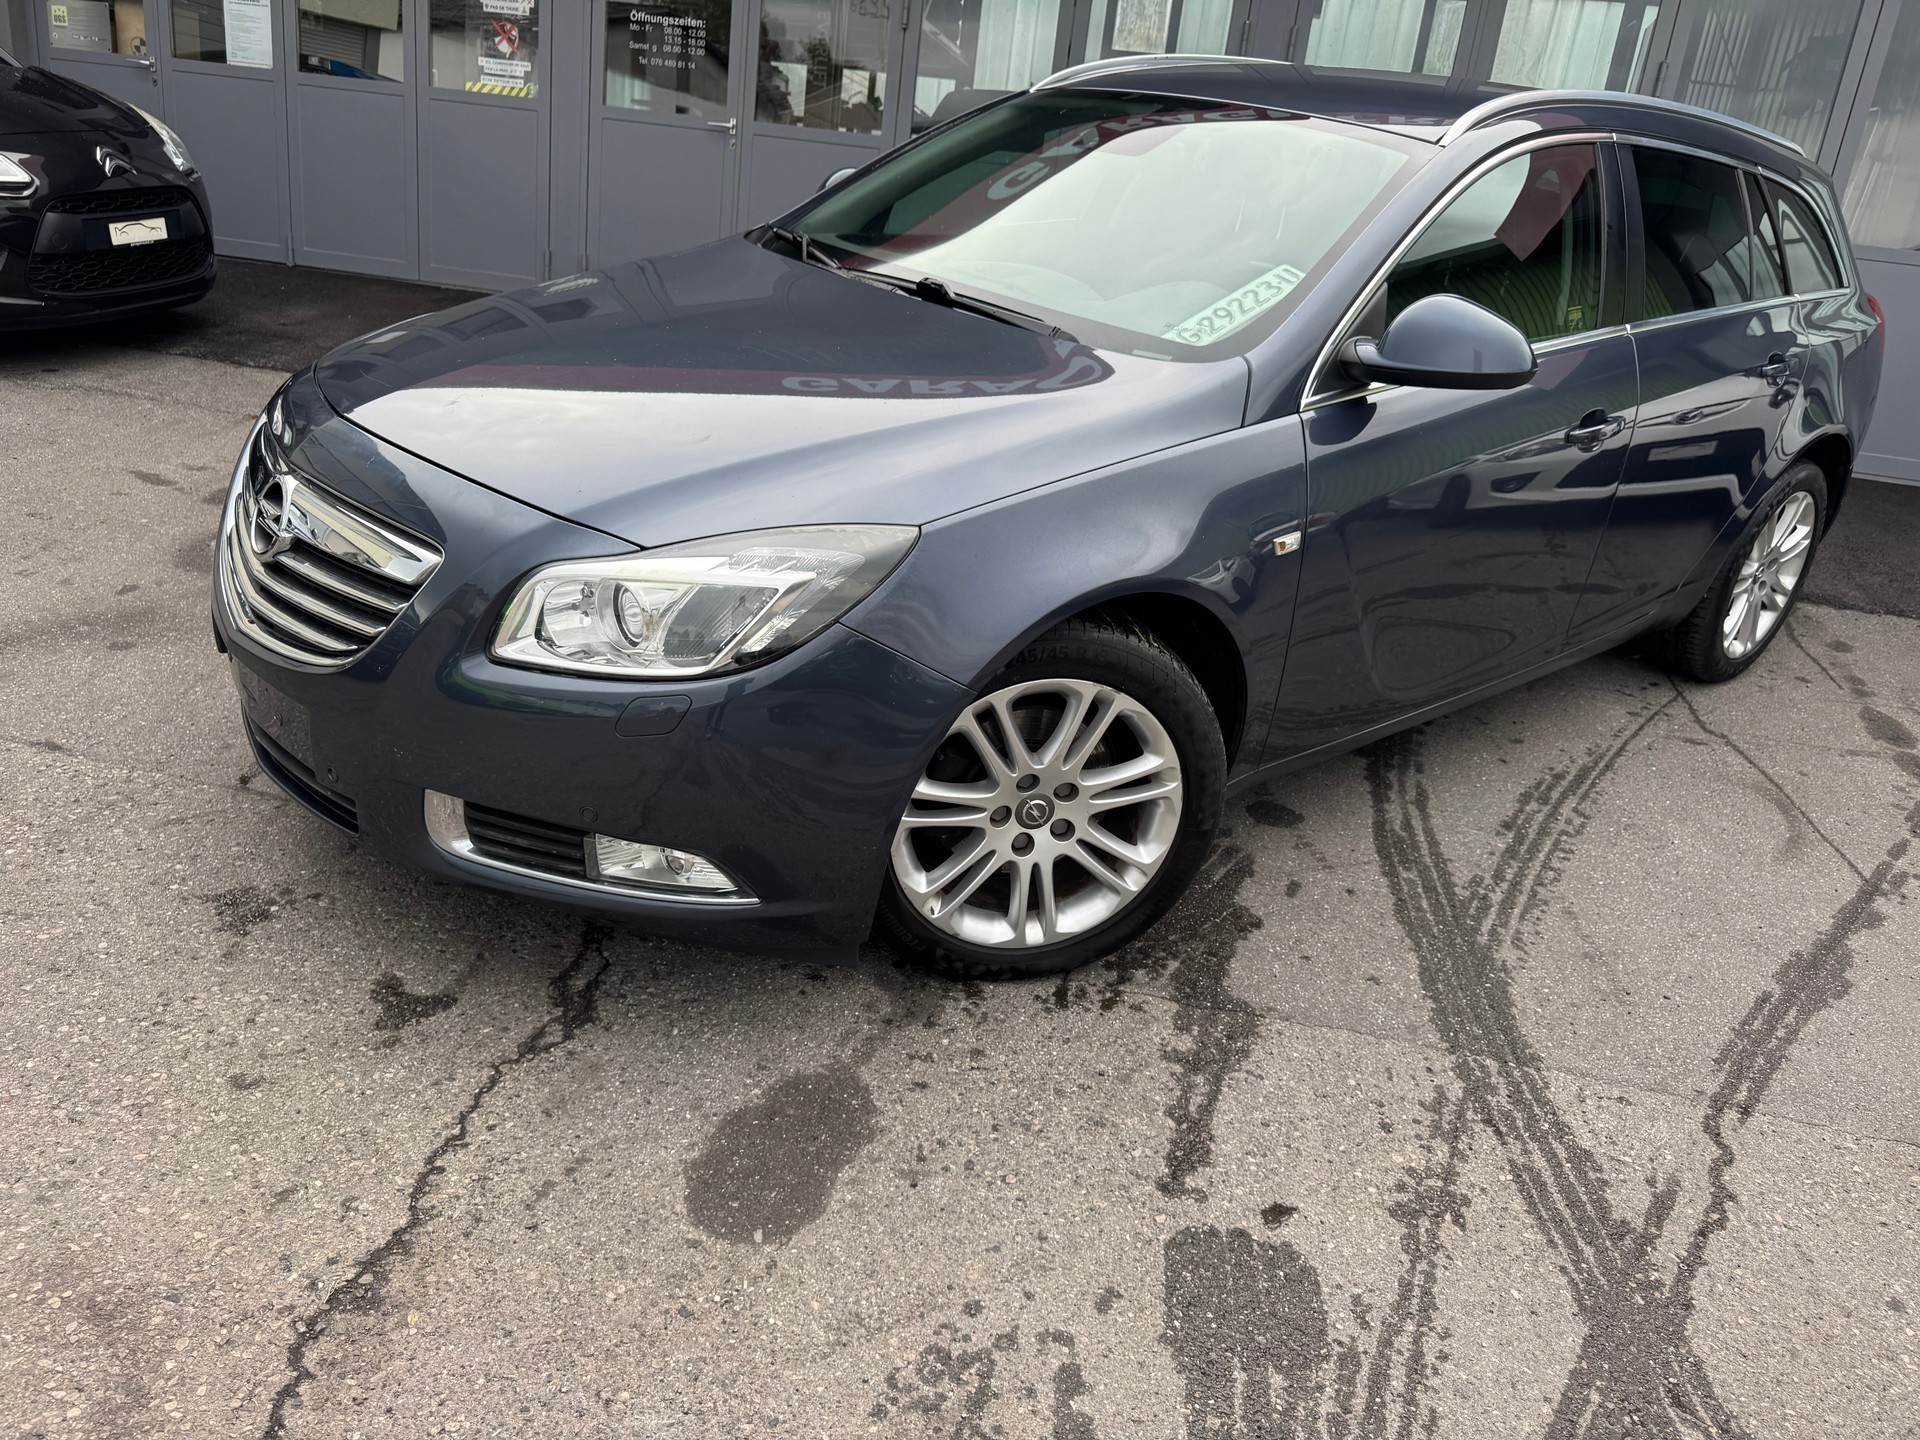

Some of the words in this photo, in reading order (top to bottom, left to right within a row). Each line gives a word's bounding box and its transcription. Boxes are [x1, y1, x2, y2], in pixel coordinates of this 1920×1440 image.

[630, 9, 706, 29] Öffnungszeiten:
[629, 23, 640, 31] Mo
[645, 24, 653, 32] Fr
[663, 26, 683, 35] 08.00
[688, 29, 706, 38] 12.00
[664, 35, 682, 44] 13.15
[687, 38, 706, 47] 18.00
[662, 44, 682, 54] 08.00
[687, 47, 706, 56] 12.00
[638, 56, 649, 64] Tel.
[650, 58, 663, 66] 076
[663, 60, 677, 68] 489
[677, 61, 686, 69] 81
